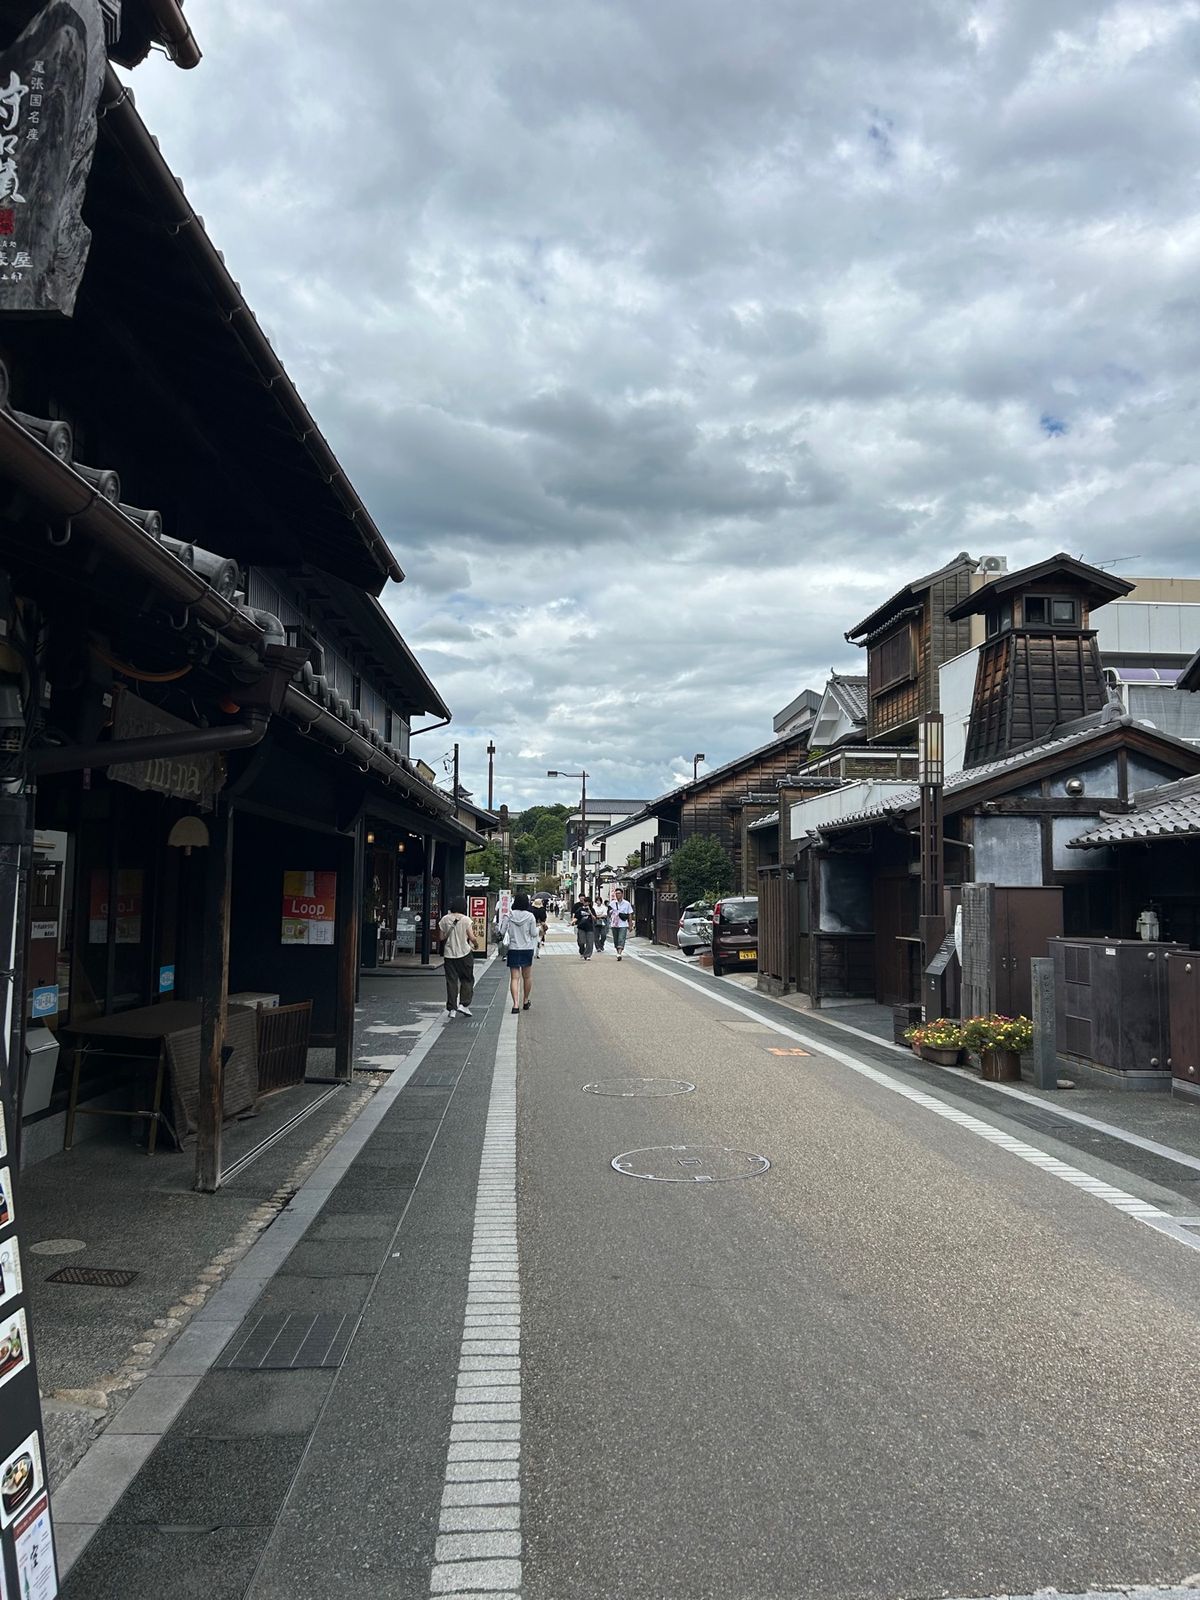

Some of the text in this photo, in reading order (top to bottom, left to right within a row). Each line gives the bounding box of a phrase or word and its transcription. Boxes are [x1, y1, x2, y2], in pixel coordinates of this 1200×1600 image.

[26, 60, 45, 141] 尾張国名産
[291, 899, 325, 916] Loop
[474, 899, 484, 908] P
